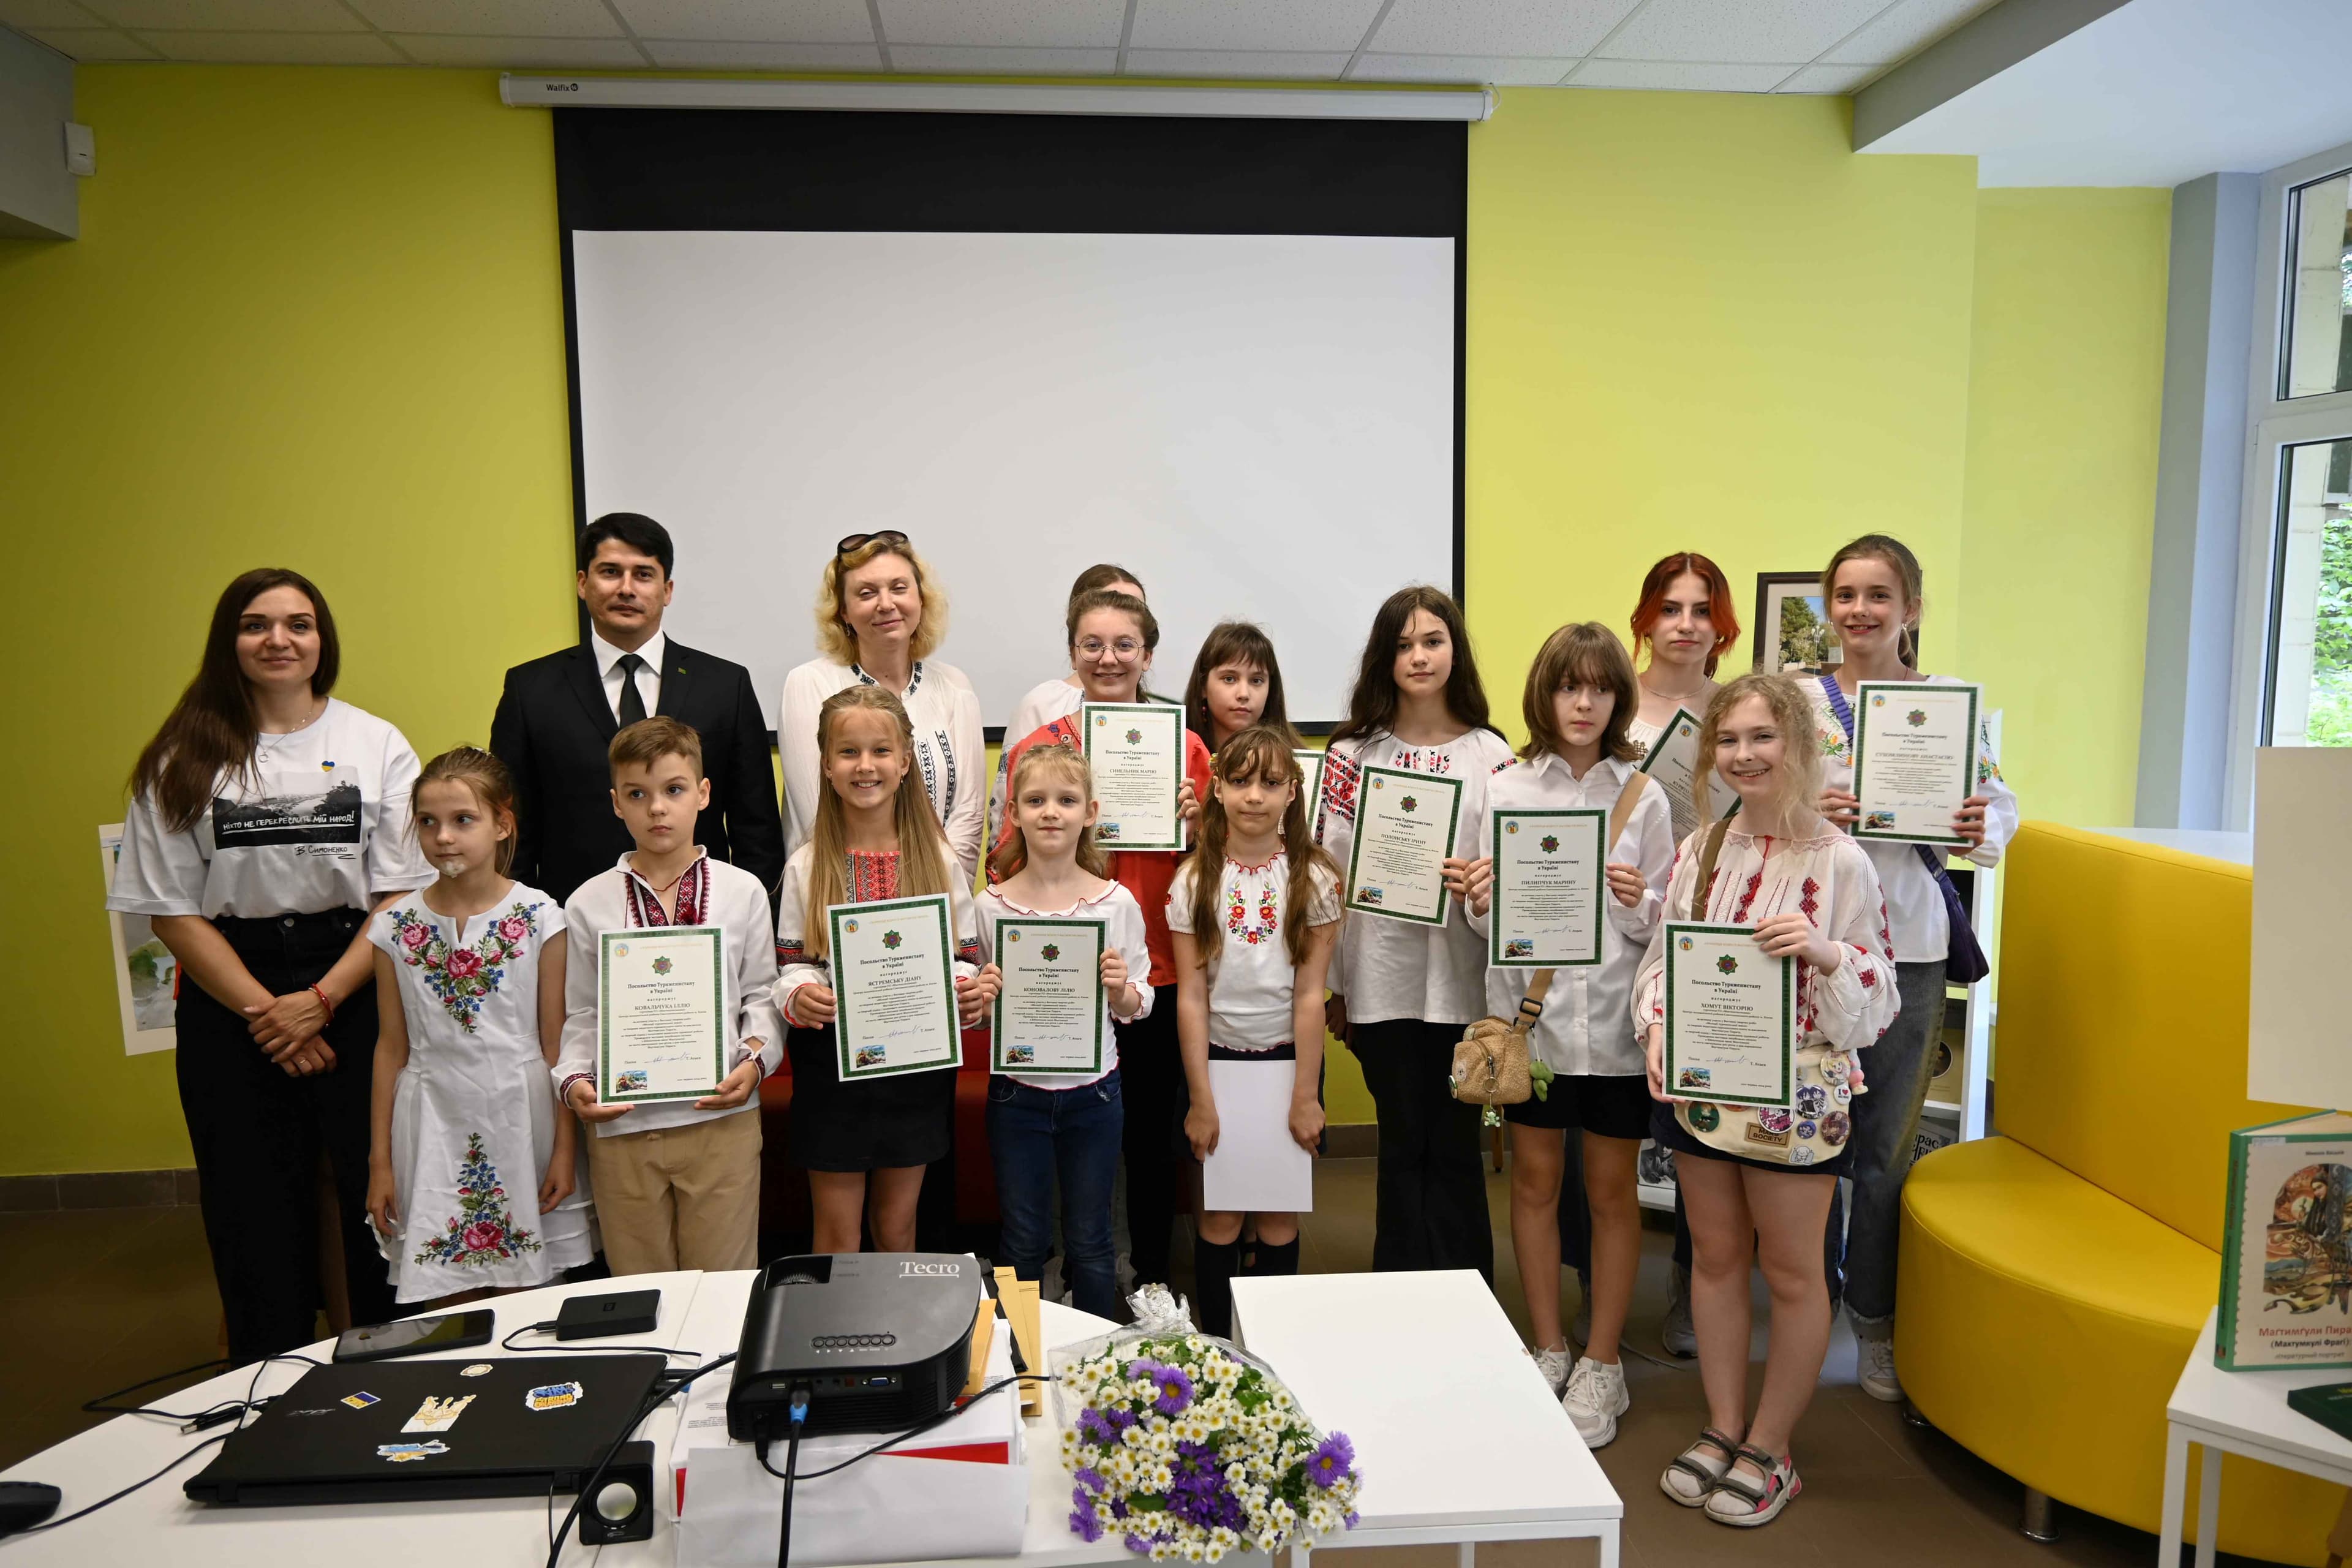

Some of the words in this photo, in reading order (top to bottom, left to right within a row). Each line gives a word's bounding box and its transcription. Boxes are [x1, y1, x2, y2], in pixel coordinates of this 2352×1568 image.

[244, 820, 255, 828] НЕ
[330, 810, 355, 823] НАРОД!
[1753, 1133, 1782, 1142] SOCIETY
[900, 1261, 960, 1275] Tecro
[2326, 1325, 2352, 1336] Пира
